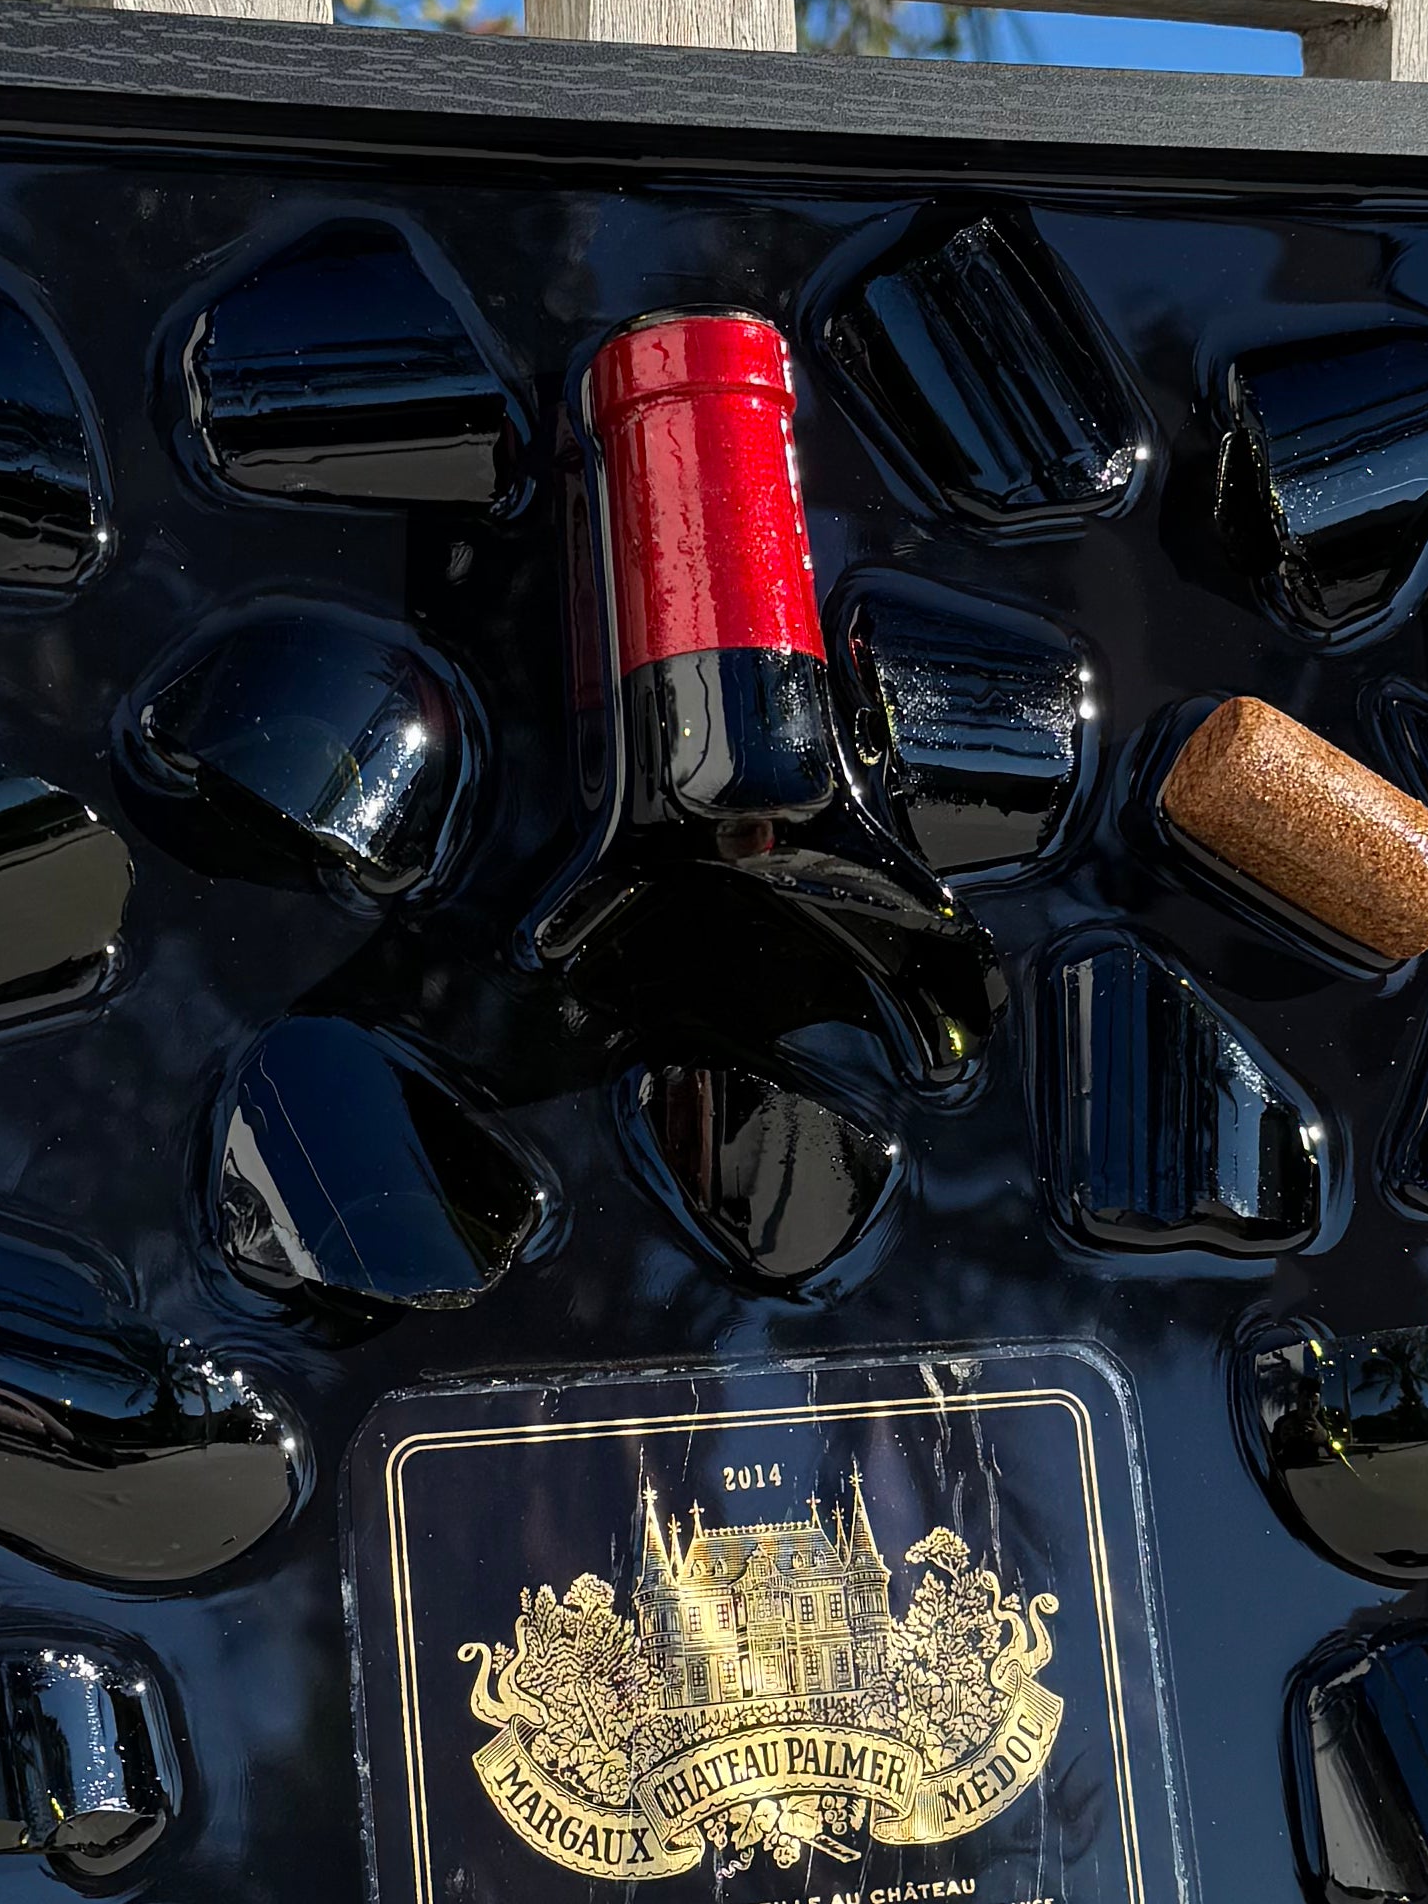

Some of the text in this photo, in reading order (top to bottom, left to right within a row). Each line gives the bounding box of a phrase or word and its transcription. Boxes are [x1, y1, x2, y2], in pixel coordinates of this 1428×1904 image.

[722, 1463, 782, 1491] 2014
[492, 1760, 655, 1865] MARGAUX
[655, 1736, 907, 1818] CHATEAU PALMER
[941, 1711, 1046, 1823] MEDOC
